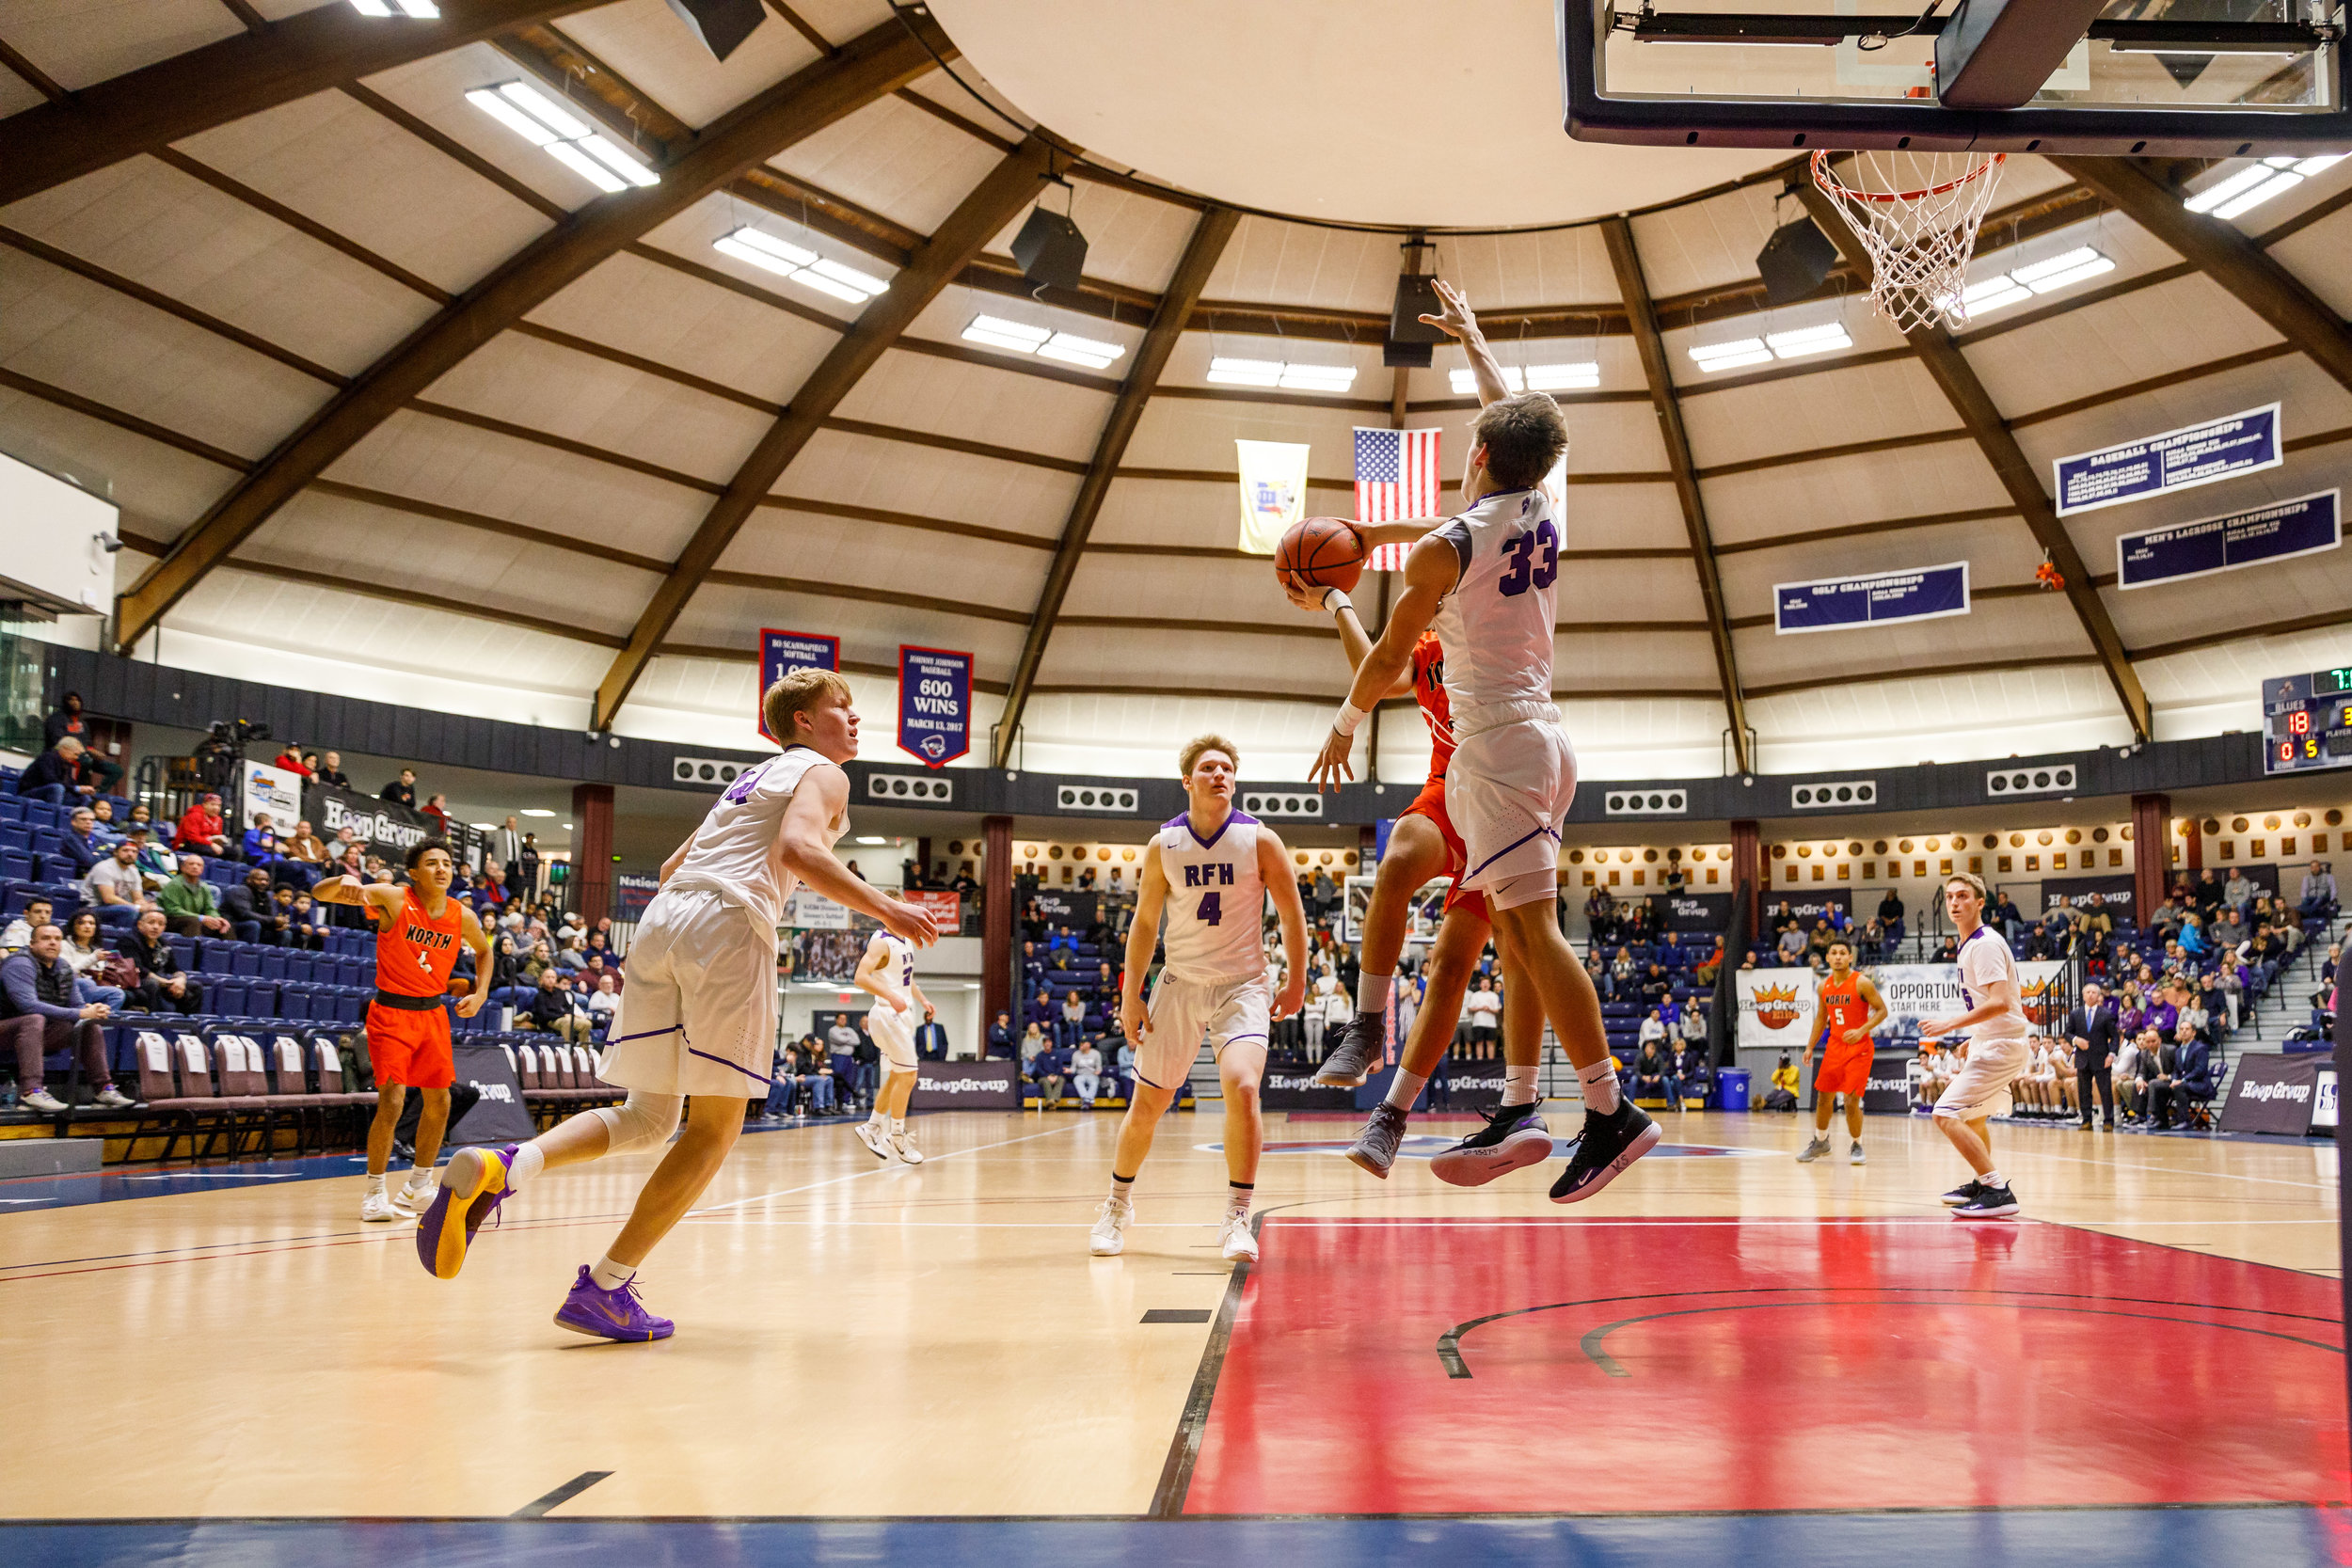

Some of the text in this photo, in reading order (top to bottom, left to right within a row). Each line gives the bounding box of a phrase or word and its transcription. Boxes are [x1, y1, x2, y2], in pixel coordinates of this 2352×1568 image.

[2090, 445, 2147, 467] BASEBALL
[2150, 420, 2244, 451] CHAMPIONSHIPS
[2176, 519, 2224, 539] LACROSSE
[2227, 502, 2309, 528] CHAMPIONSHIPS
[1499, 519, 1558, 597] 33
[1812, 585, 1836, 595] GOLF
[1840, 575, 1924, 593] CHAMPIONSHIPS
[919, 678, 953, 698] 600
[913, 696, 959, 716] WINS
[907, 718, 934, 730] MARCH
[946, 721, 963, 733] 2017
[2289, 710, 2309, 735] 18
[2280, 742, 2294, 761] 0
[2305, 738, 2318, 758] 5
[1184, 863, 1234, 887] RFH
[1197, 892, 1222, 927] 4
[405, 924, 453, 950] NORTH
[1825, 994, 1851, 1006] NORTH
[1890, 983, 1960, 1000] OPPORTUN
[1835, 1007, 1845, 1025] 5
[1891, 1002, 1916, 1012] START
[1919, 1001, 1941, 1011] HERE
